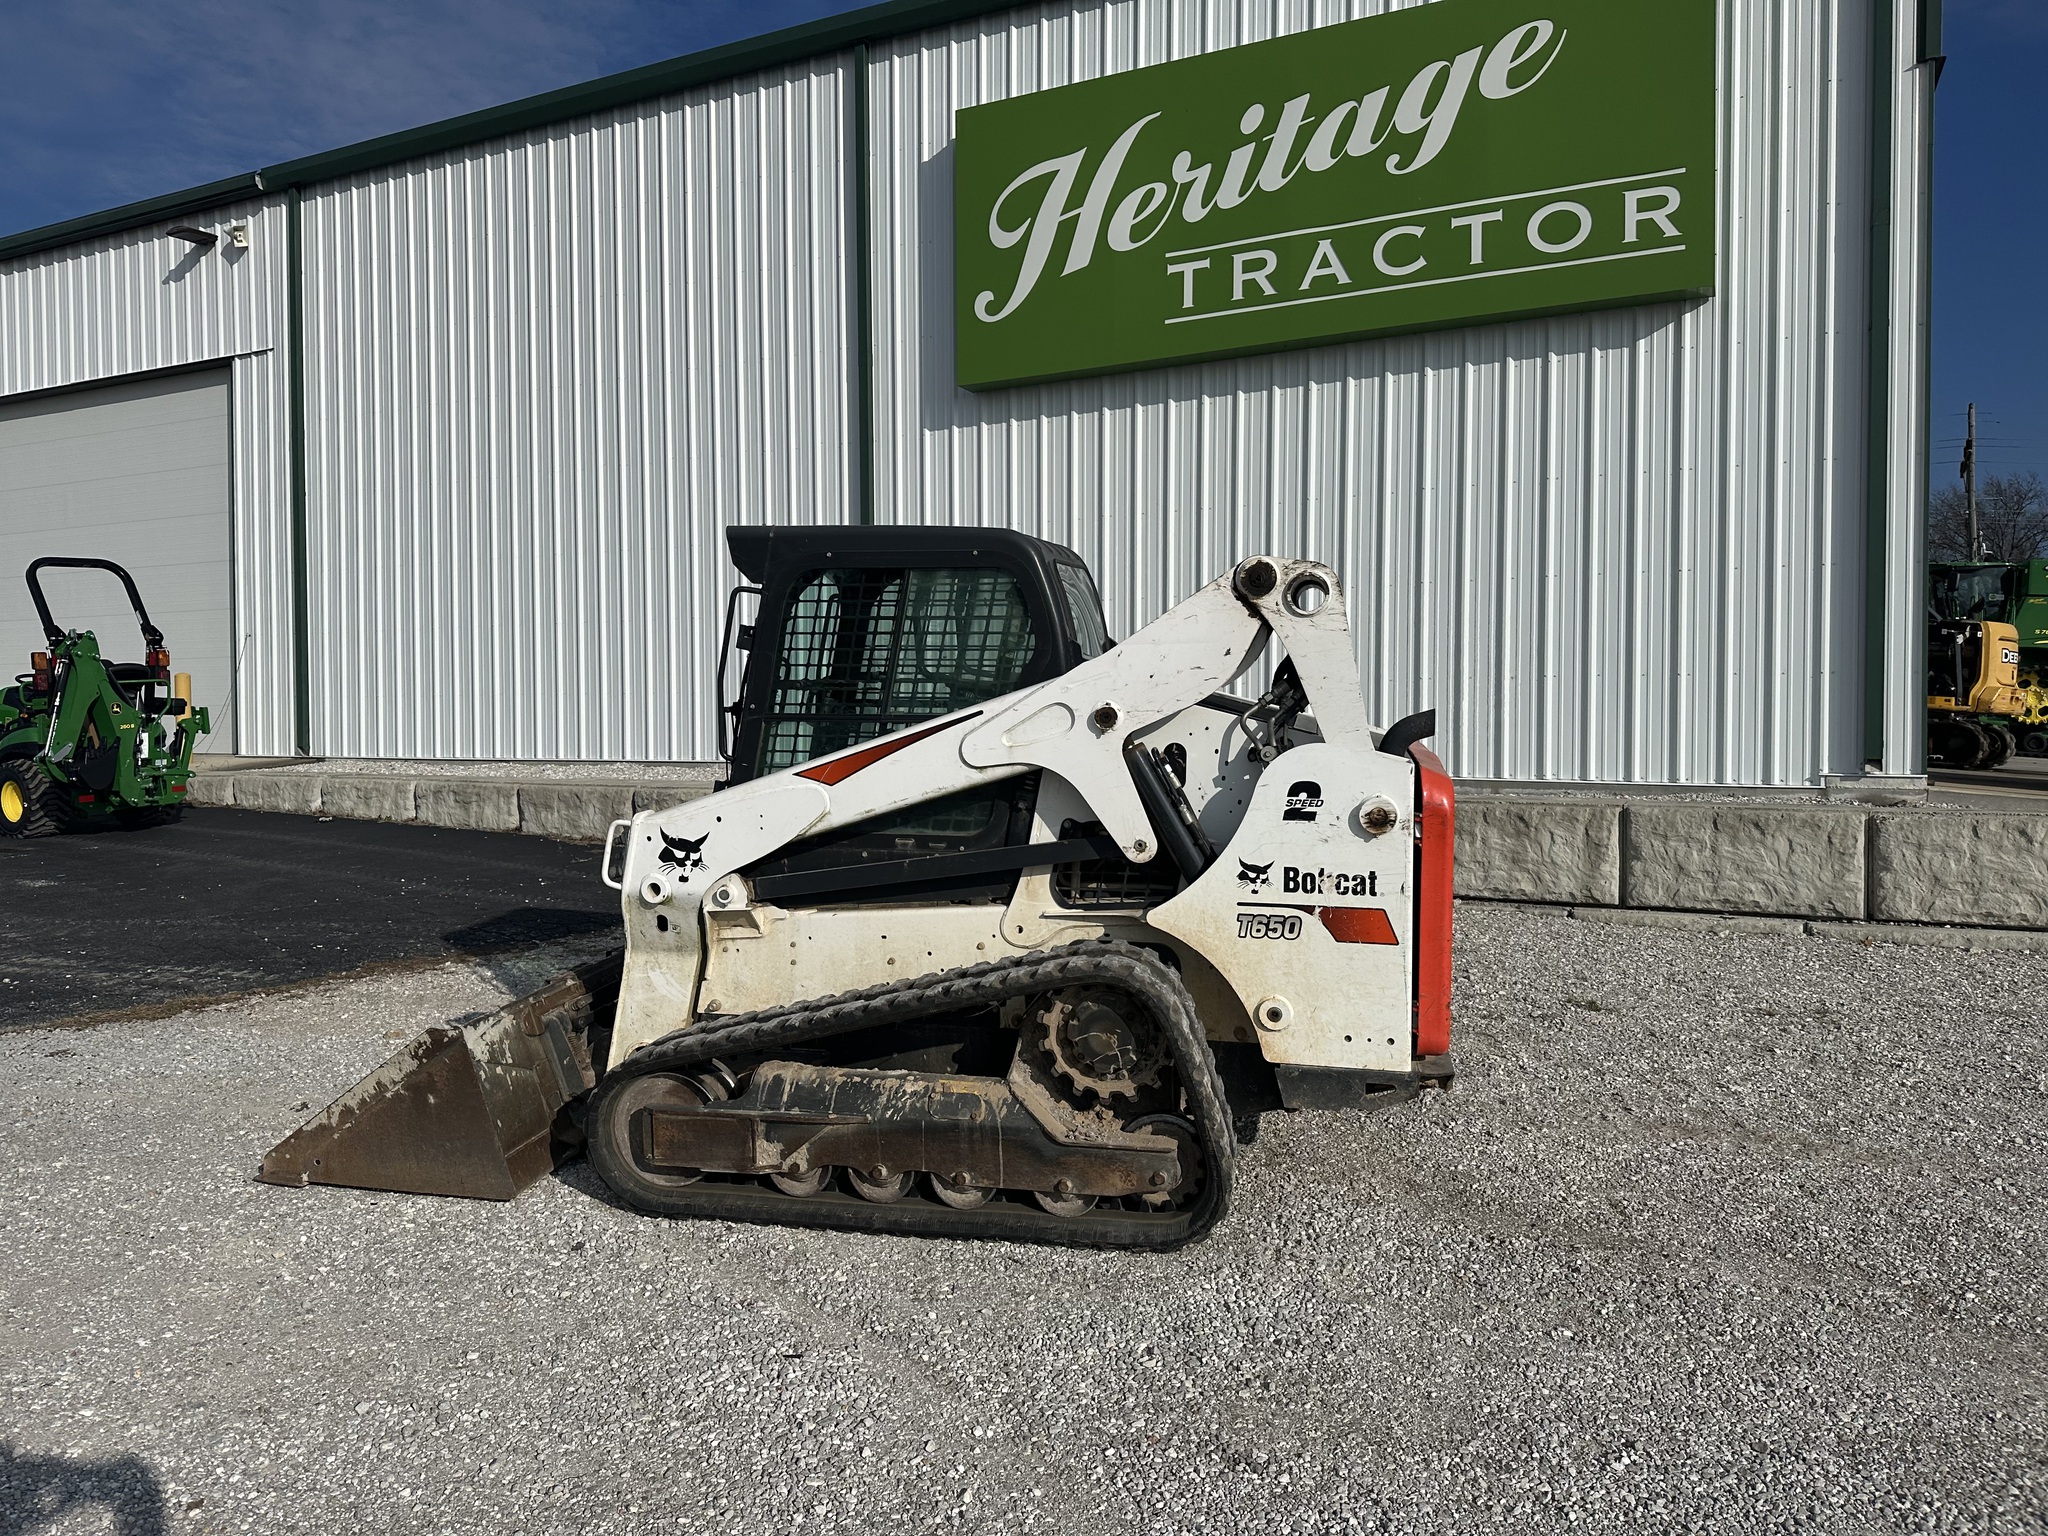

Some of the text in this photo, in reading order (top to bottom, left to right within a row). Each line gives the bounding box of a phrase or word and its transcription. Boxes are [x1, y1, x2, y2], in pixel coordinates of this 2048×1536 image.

[974, 19, 1567, 324] Heritage
[1166, 185, 1684, 309] TRACTOR
[1282, 780, 1322, 821] 2
[1285, 798, 1325, 808] SPEED
[1237, 913, 1303, 940] T650
